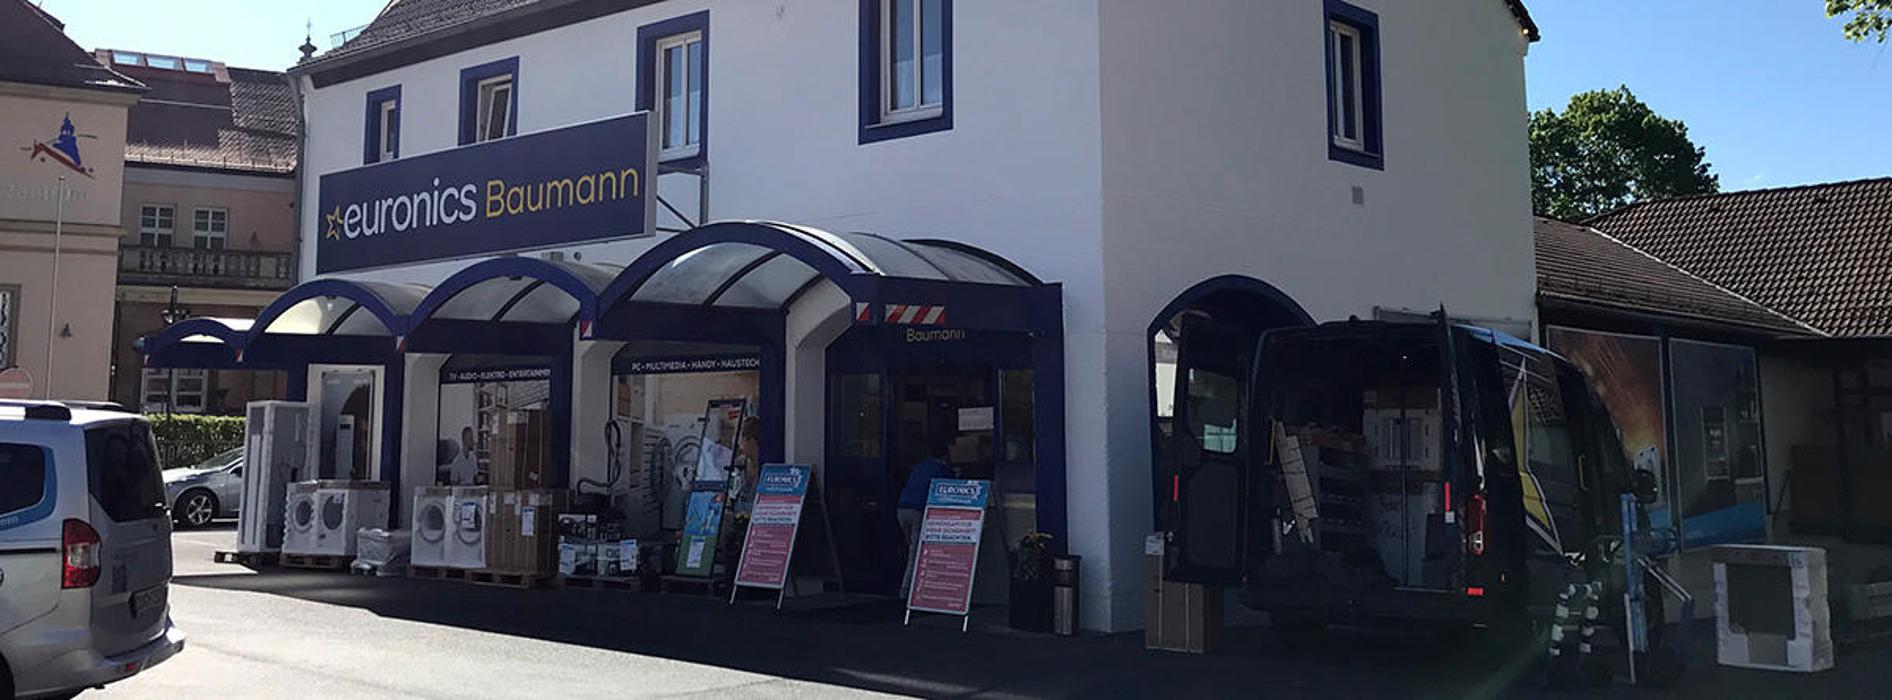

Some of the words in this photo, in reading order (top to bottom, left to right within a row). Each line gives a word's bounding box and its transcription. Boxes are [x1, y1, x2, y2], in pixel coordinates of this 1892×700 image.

[343, 177, 478, 239] euronics
[486, 167, 639, 219] Baumann
[906, 328, 967, 343] Baumann
[631, 361, 641, 371] PC
[646, 360, 687, 371] MULTIMEDIA
[691, 360, 716, 369] HANDY
